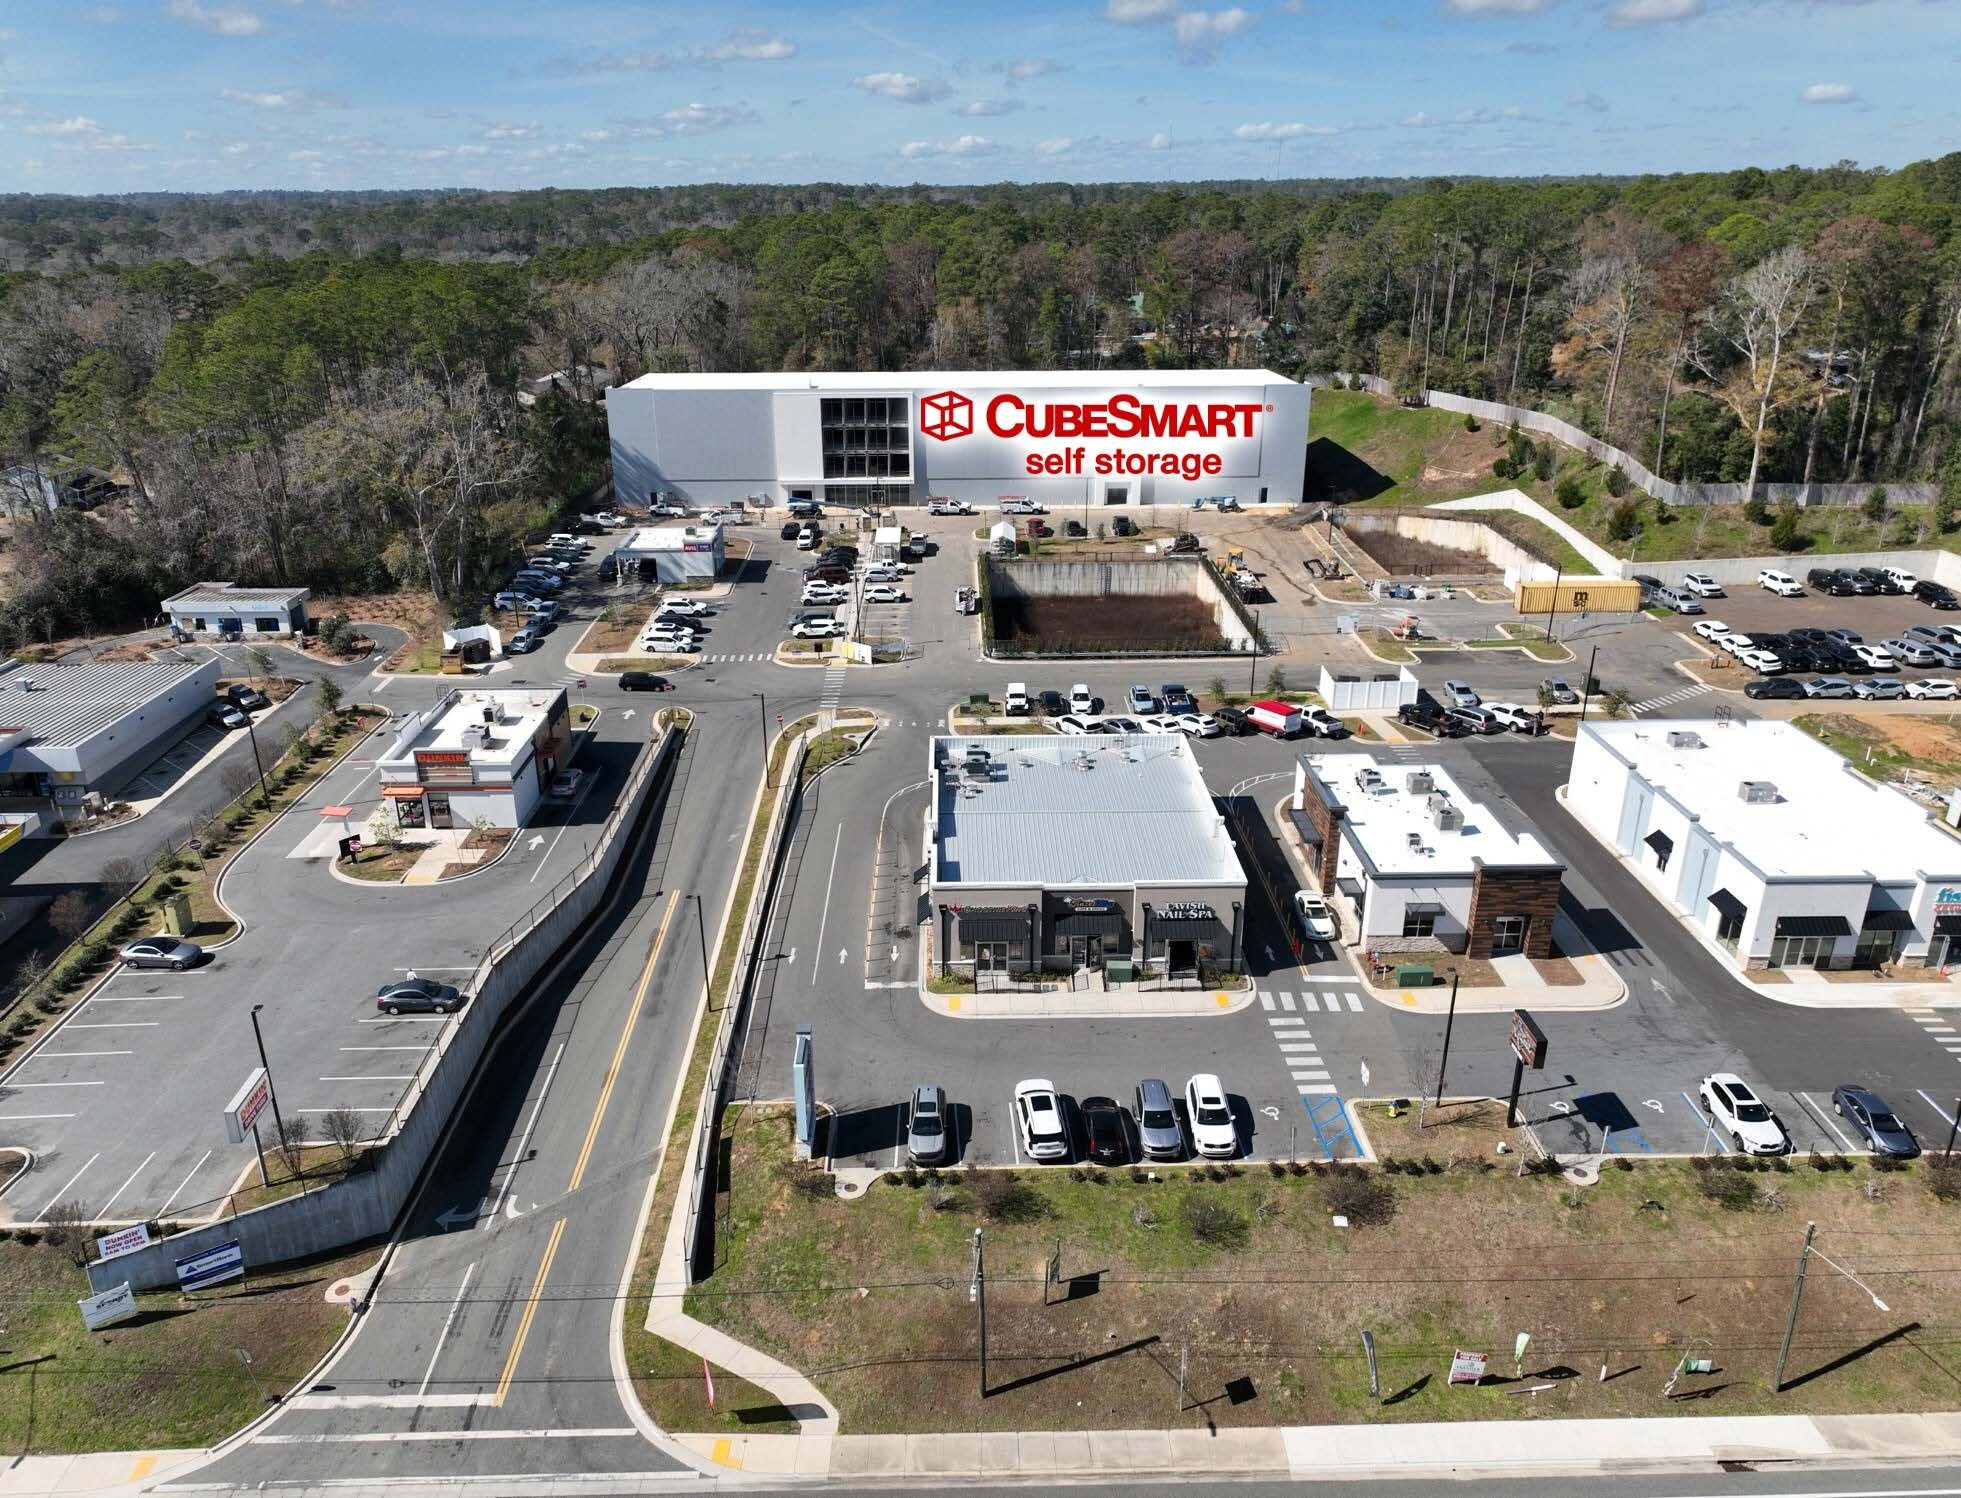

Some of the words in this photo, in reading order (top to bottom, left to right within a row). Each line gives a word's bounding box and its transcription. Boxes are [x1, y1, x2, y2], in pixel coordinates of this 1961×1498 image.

[1166, 902, 1205, 910] LAVISH
[1156, 910, 1184, 919] NAIL
[1188, 909, 1212, 919] SPA
[105, 1241, 123, 1251] NOW
[124, 1235, 143, 1245] OPEN
